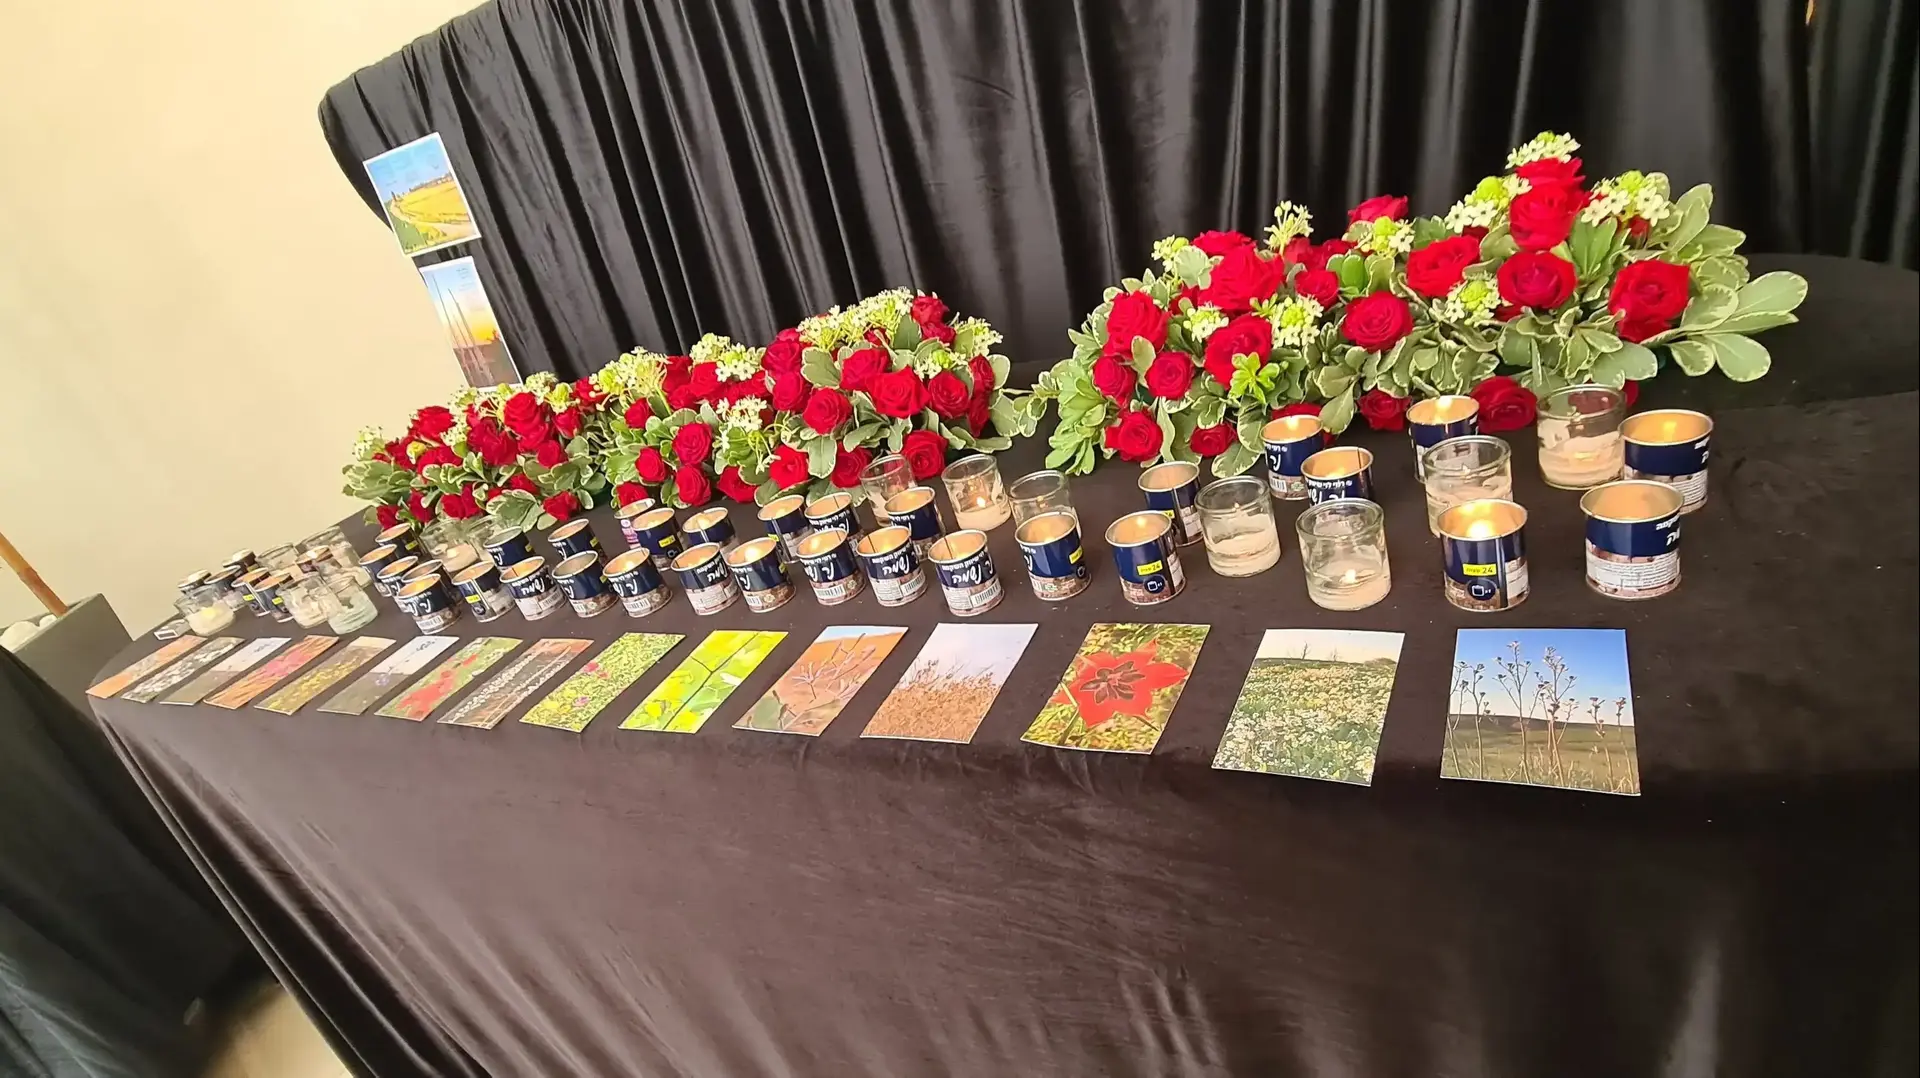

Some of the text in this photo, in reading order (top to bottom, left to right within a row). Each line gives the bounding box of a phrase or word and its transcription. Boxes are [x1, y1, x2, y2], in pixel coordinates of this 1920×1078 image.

[1270, 454, 1281, 471] נר
[822, 562, 835, 580] נר
[882, 554, 910, 575] נשמה
[951, 563, 982, 584] נשמה
[520, 577, 545, 596] נשמה
[626, 578, 638, 594] נר
[740, 574, 751, 590] נר
